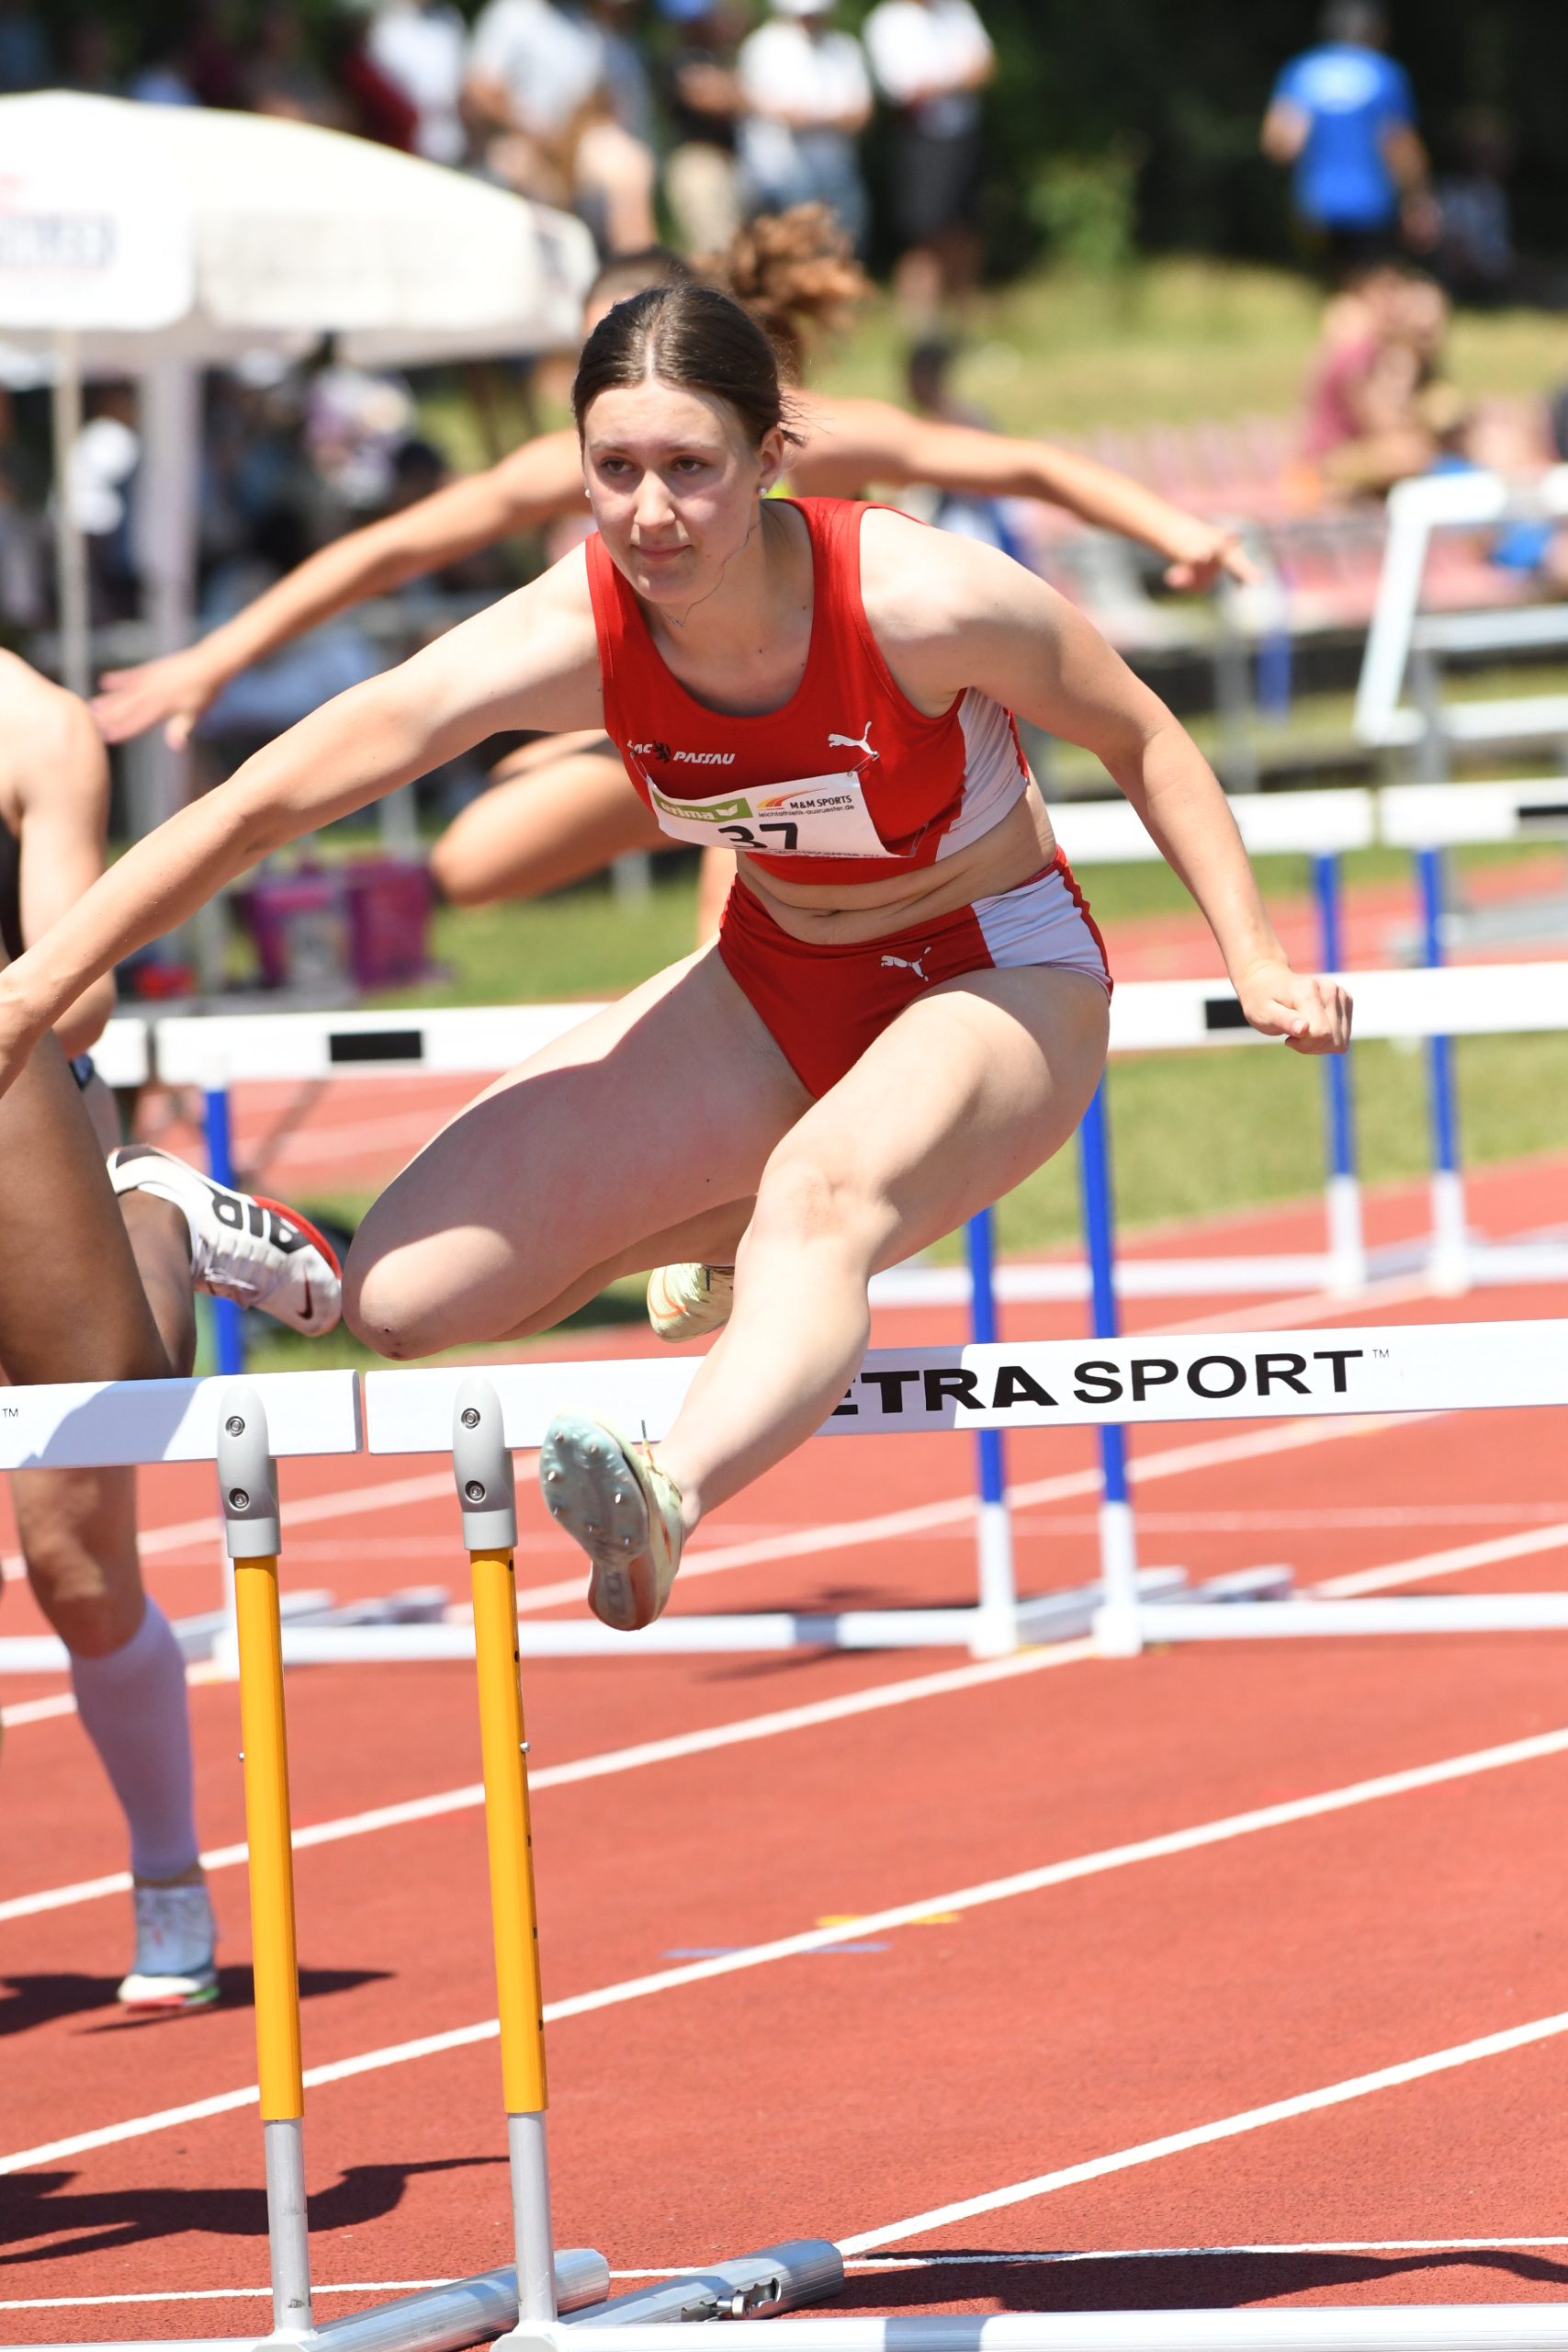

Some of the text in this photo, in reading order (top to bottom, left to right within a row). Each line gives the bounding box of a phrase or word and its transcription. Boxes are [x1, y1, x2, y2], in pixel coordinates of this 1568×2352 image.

[626, 738, 736, 765] LAC PASSAU
[660, 801, 716, 821] erima
[758, 803, 855, 819] leichtathletik-ausruester.de
[789, 794, 852, 809] M&M SPORTS
[717, 821, 798, 851] 37
[207, 1185, 312, 1254] AIR
[1072, 1349, 1364, 1405] SPORT
